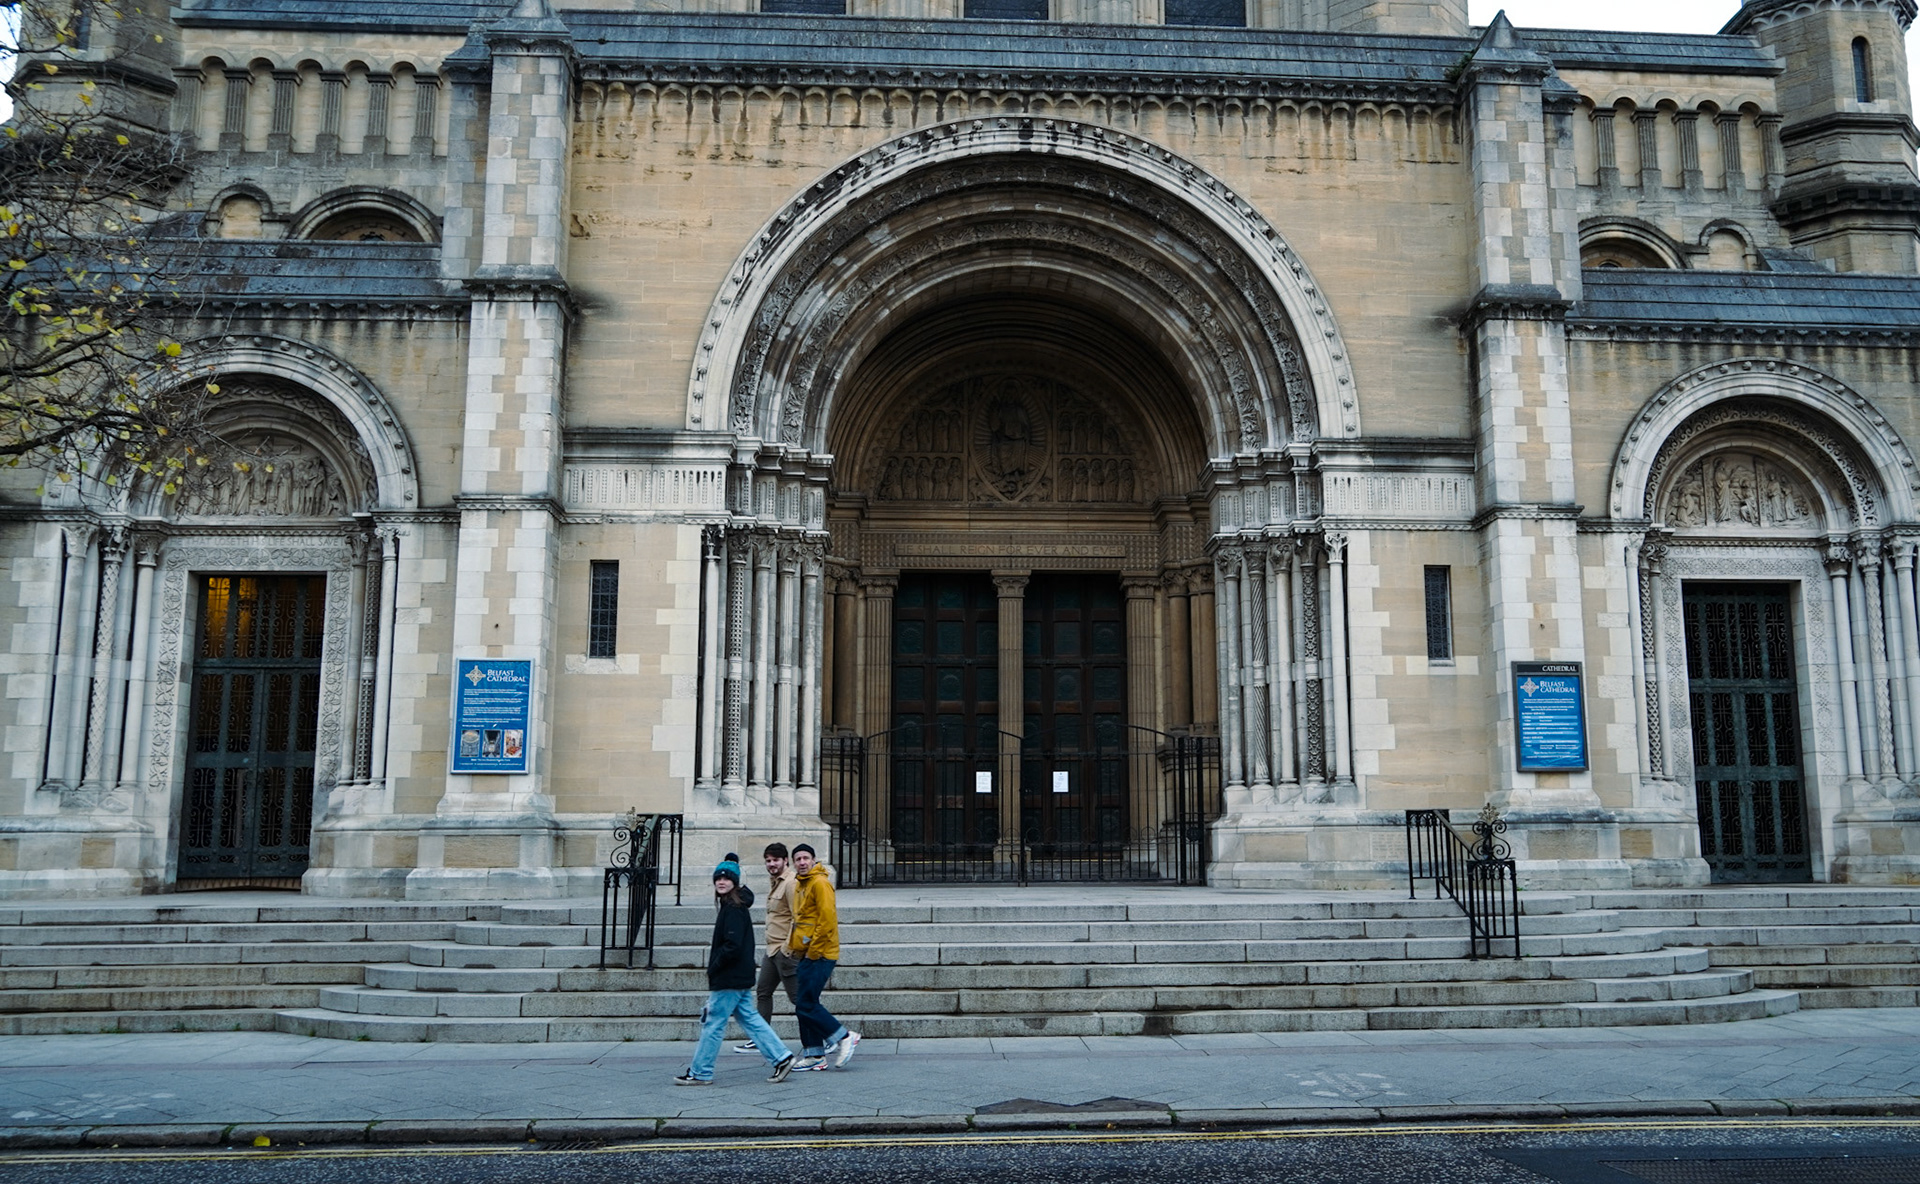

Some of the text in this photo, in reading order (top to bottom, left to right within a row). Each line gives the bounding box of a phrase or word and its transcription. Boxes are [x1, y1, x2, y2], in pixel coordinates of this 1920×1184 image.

[215, 537, 250, 546] LOSETH
[252, 537, 266, 546] HS
[286, 537, 316, 547] SHALL
[318, 537, 338, 547] SAVE
[896, 545, 1124, 555] HE SHALL REIGN FOR EVER AND EVER
